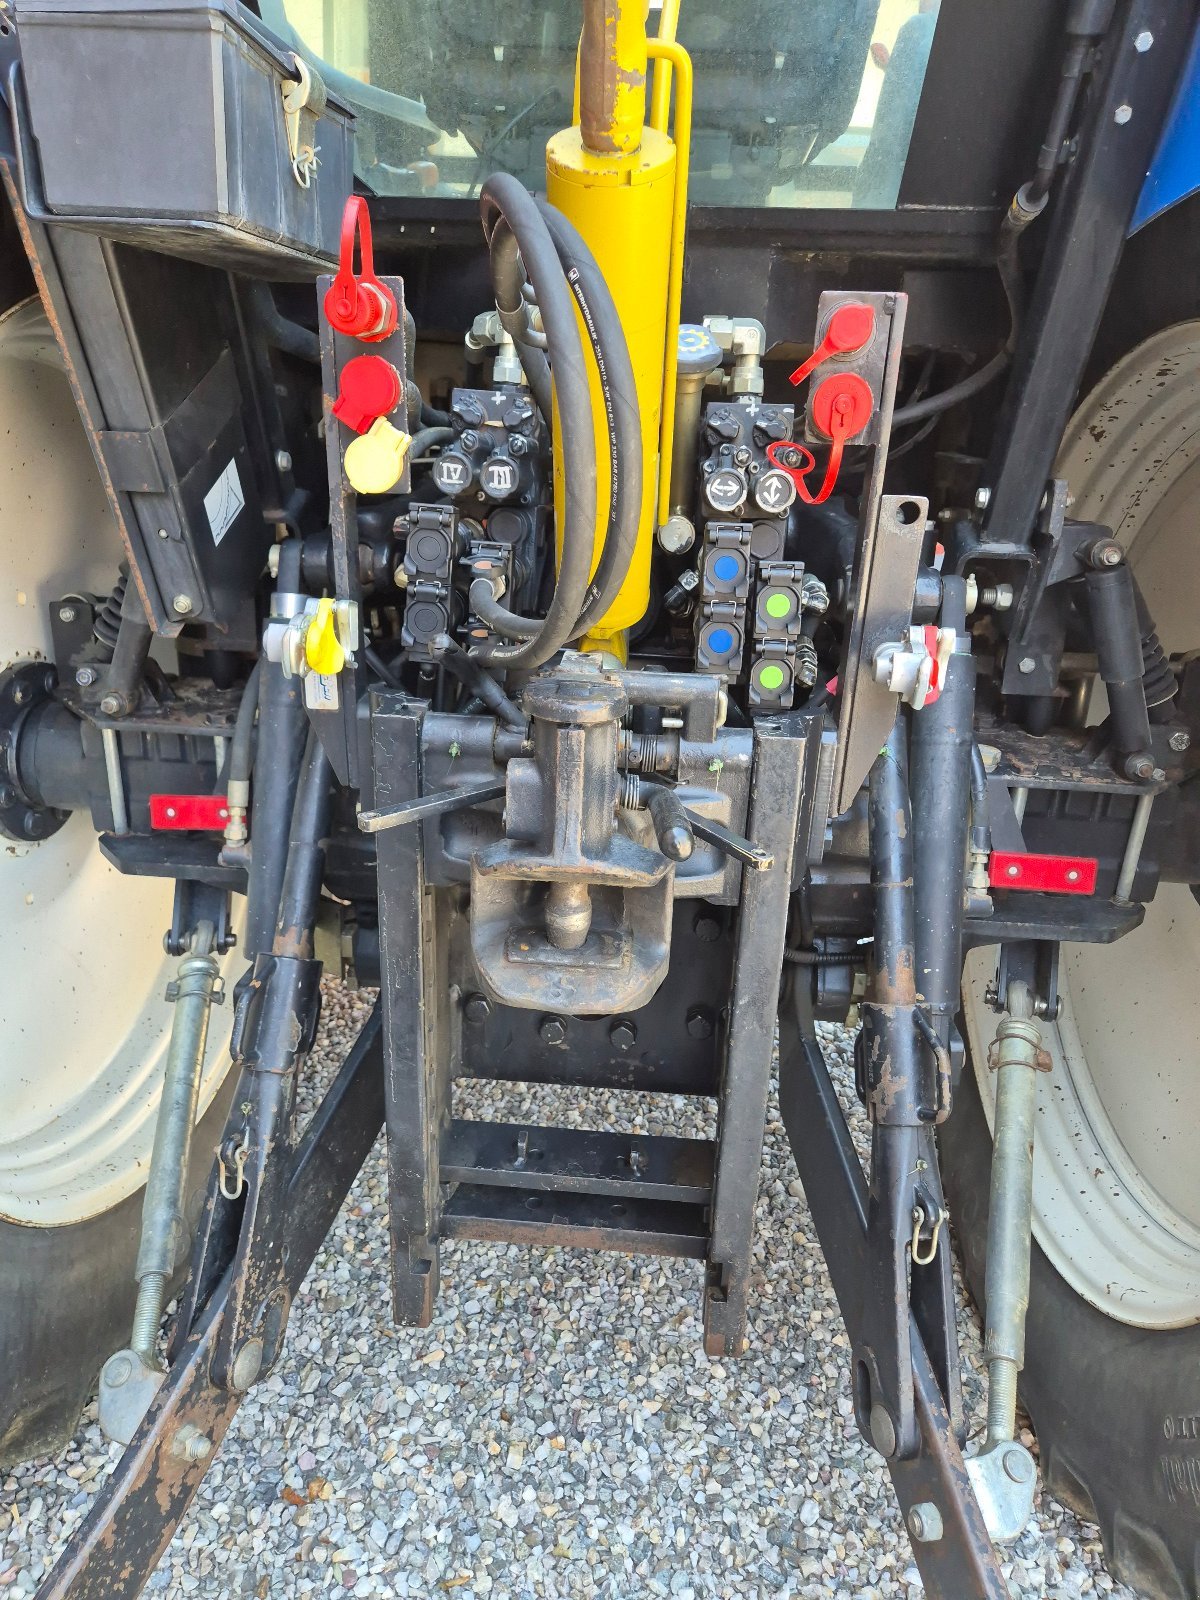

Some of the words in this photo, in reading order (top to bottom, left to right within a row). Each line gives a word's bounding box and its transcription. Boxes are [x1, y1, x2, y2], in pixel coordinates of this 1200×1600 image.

[574, 283, 597, 340] INTERHYDRAULIK
[599, 360, 607, 380] DN10
[440, 462, 463, 483] IV
[488, 465, 513, 489] III
